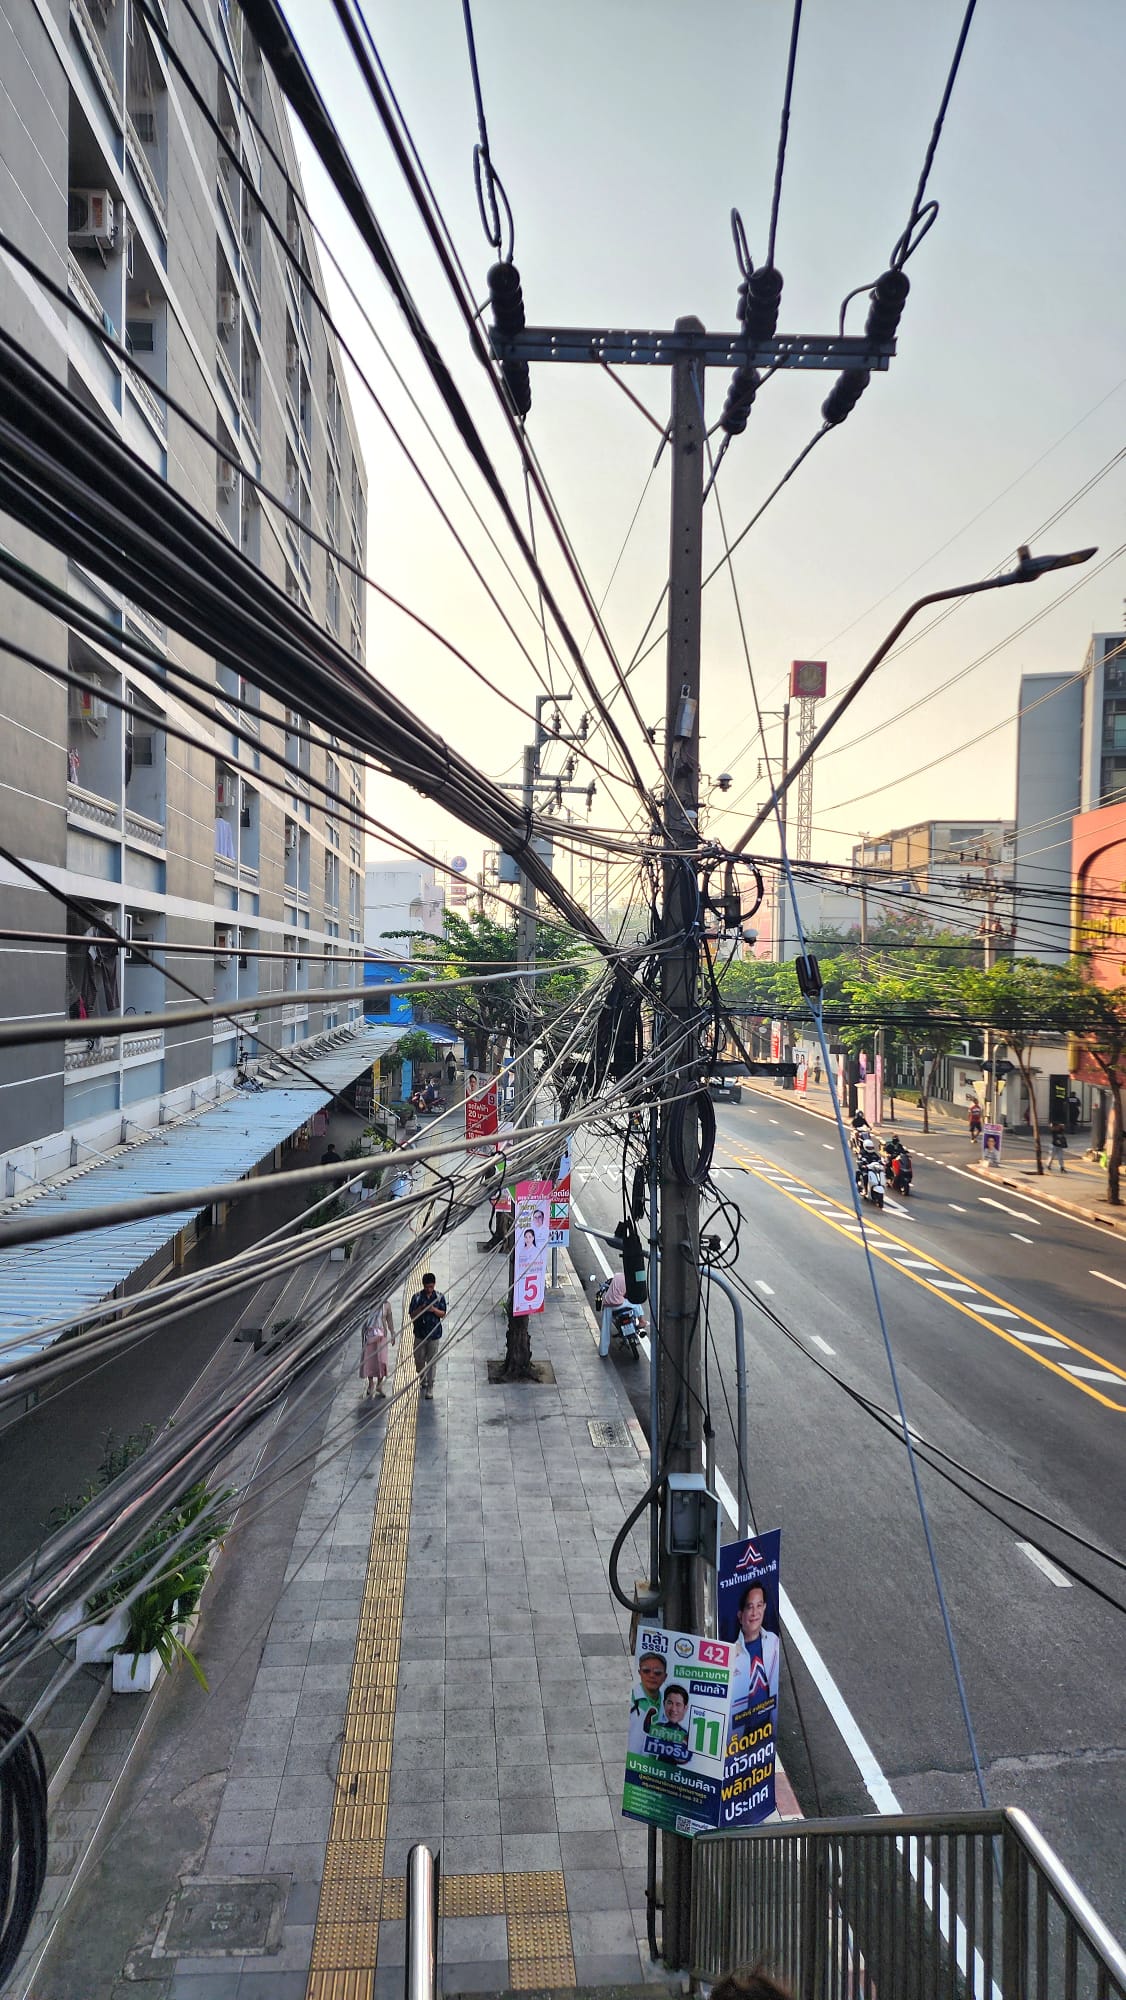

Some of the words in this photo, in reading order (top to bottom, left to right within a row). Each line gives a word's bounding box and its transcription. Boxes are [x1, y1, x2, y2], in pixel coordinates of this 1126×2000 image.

[490, 1096, 495, 1104] 9
[524, 1275, 538, 1301] 5
[641, 1643, 668, 1653] ธรรม
[642, 1632, 669, 1646] กล้า
[704, 1646, 725, 1664] 42
[693, 1684, 726, 1695] คนกล้า
[693, 1717, 720, 1756] 11
[648, 1740, 689, 1759] ทำจริง
[629, 1760, 667, 1778] ปารเมศ
[721, 1762, 772, 1802] พลิกโฉม
[725, 1784, 769, 1821] ประเทศ
